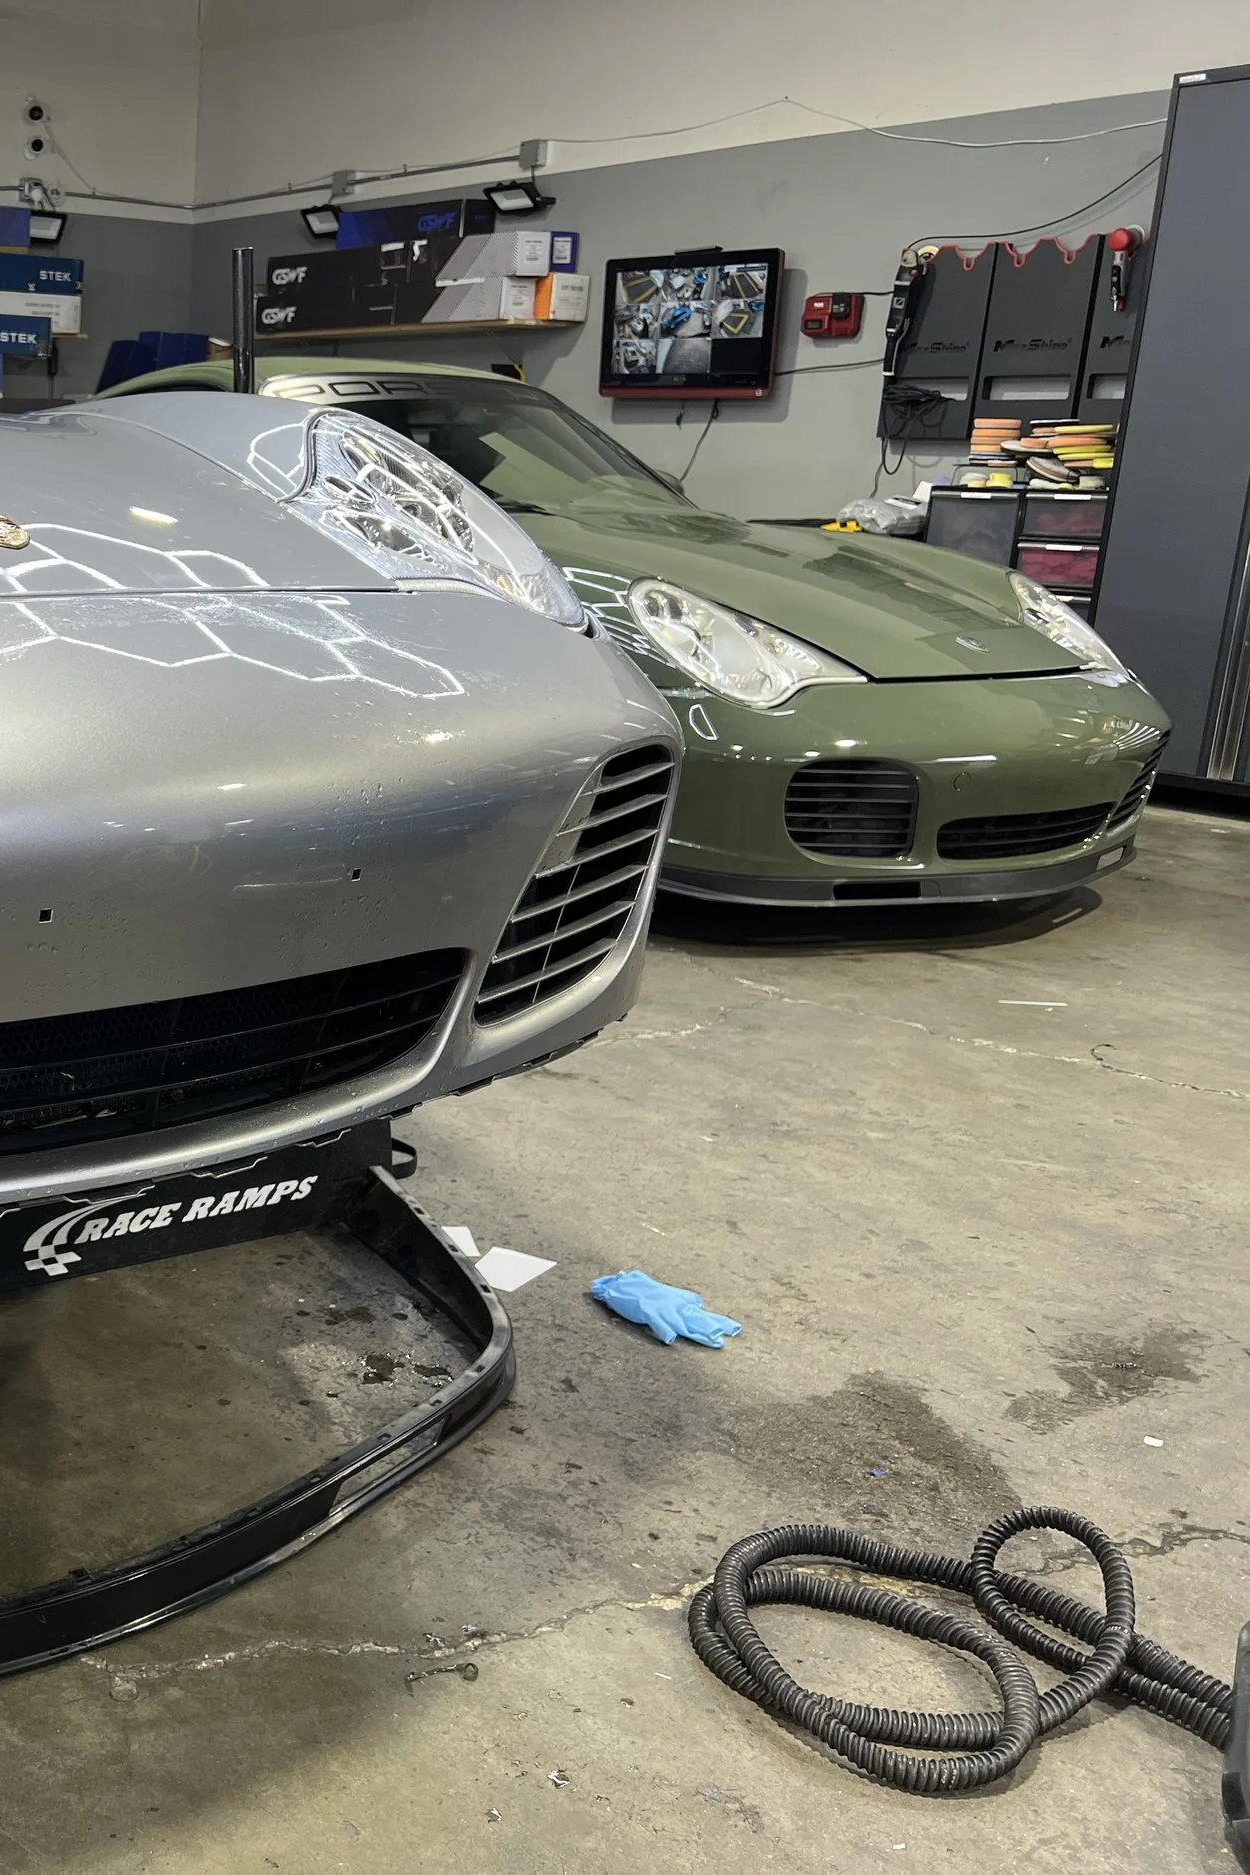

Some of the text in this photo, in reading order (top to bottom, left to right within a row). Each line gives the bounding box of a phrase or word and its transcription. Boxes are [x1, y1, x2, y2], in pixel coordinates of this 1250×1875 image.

[39, 270, 72, 282] STEK
[0, 332, 38, 345] STEK
[74, 1175, 319, 1245] RACE RAMPS
